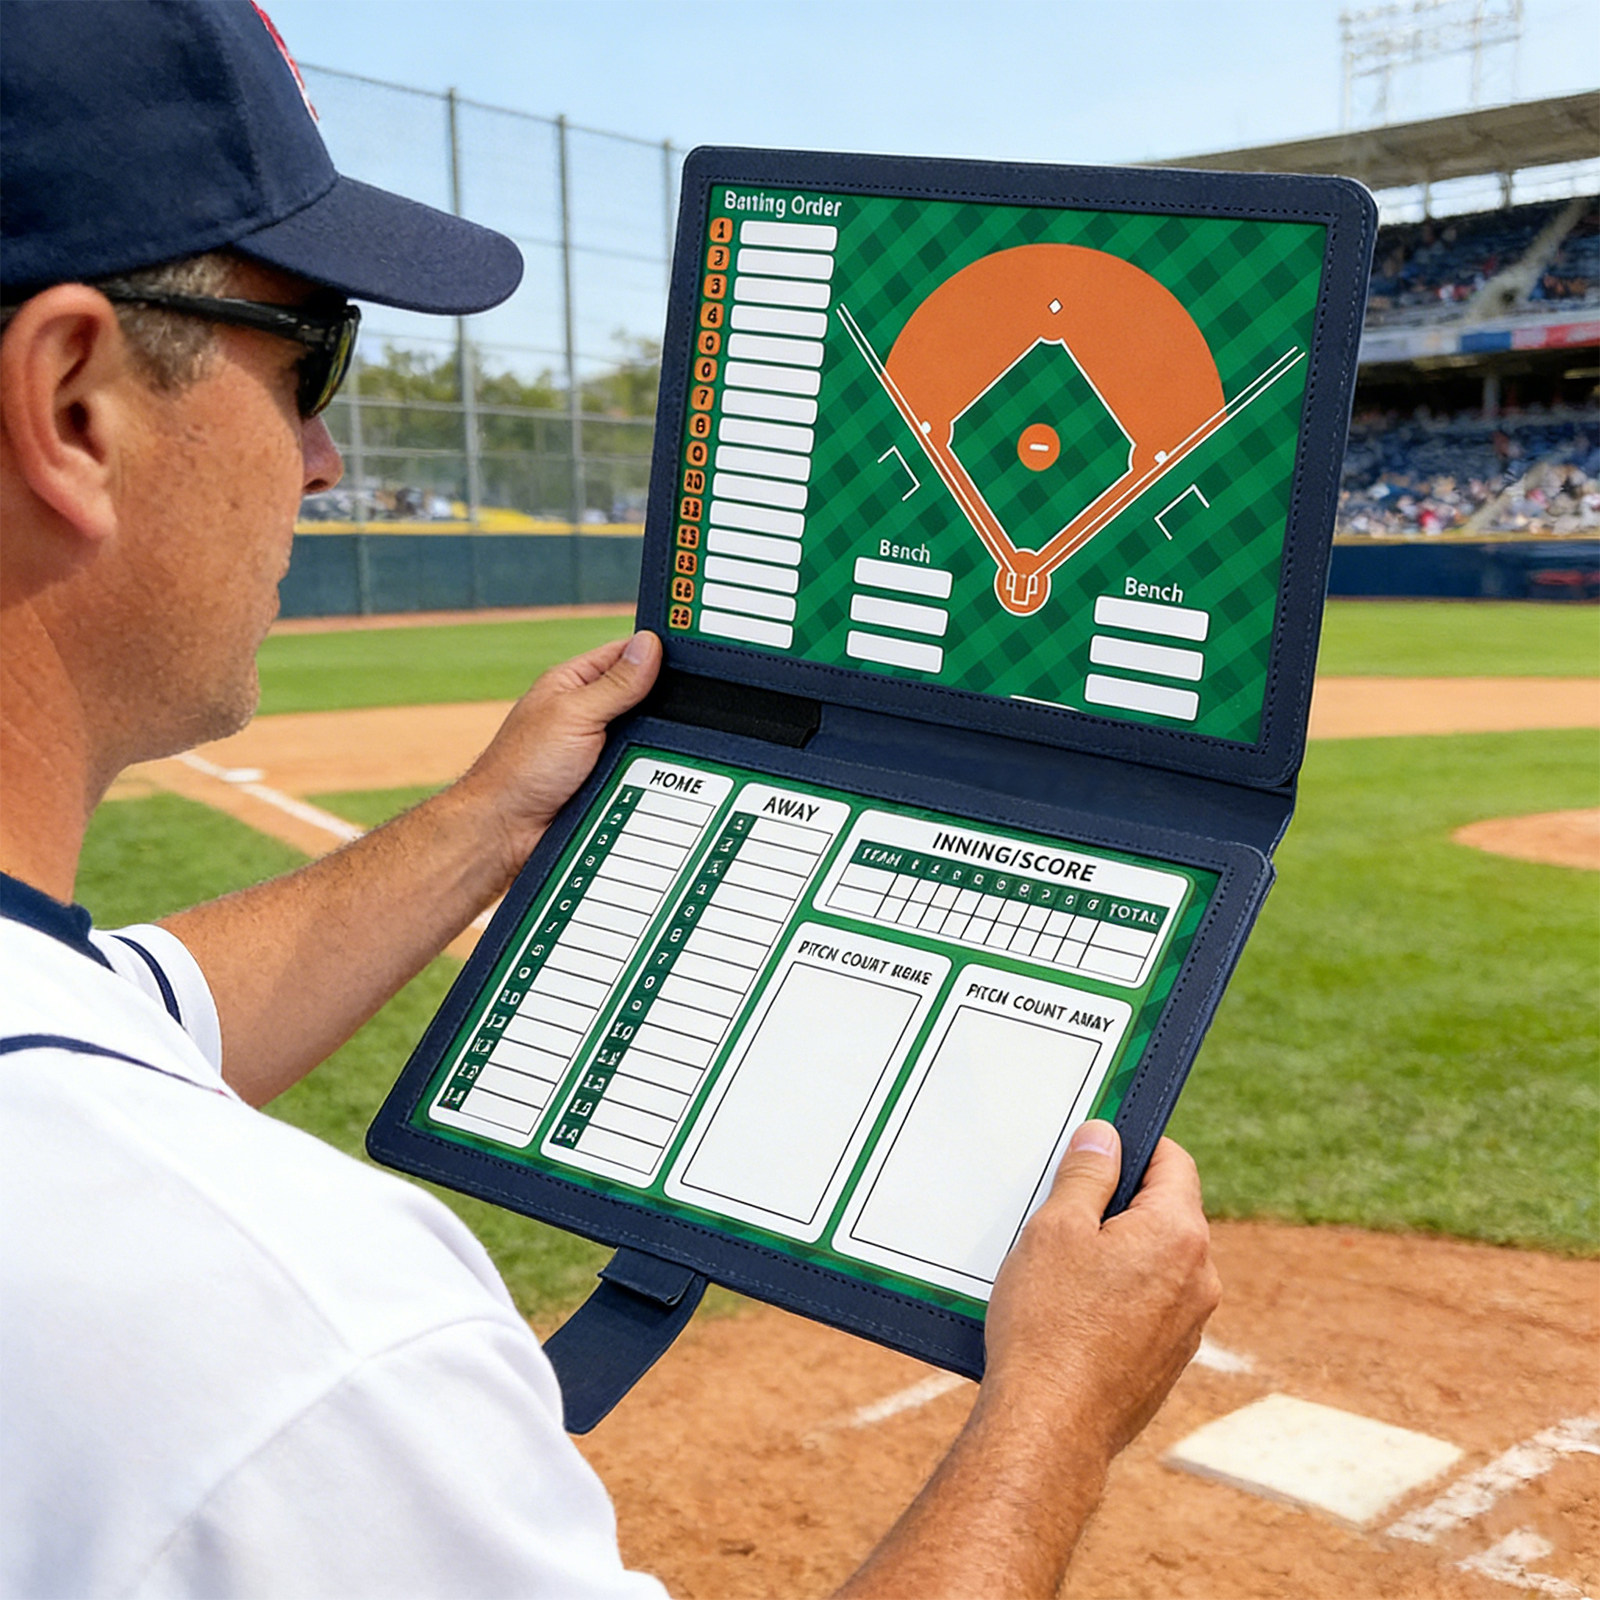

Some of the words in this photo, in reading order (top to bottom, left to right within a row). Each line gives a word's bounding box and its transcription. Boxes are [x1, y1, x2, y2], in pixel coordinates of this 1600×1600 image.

[791, 195, 842, 217] Order
[699, 389, 709, 405] 7
[879, 539, 930, 564] Bench
[1124, 576, 1183, 603] Bench
[762, 796, 820, 822] AWAY
[932, 832, 1097, 882] INNING/SCORE
[1108, 903, 1159, 926] TOTAL
[1013, 995, 1068, 1020] COUNT
